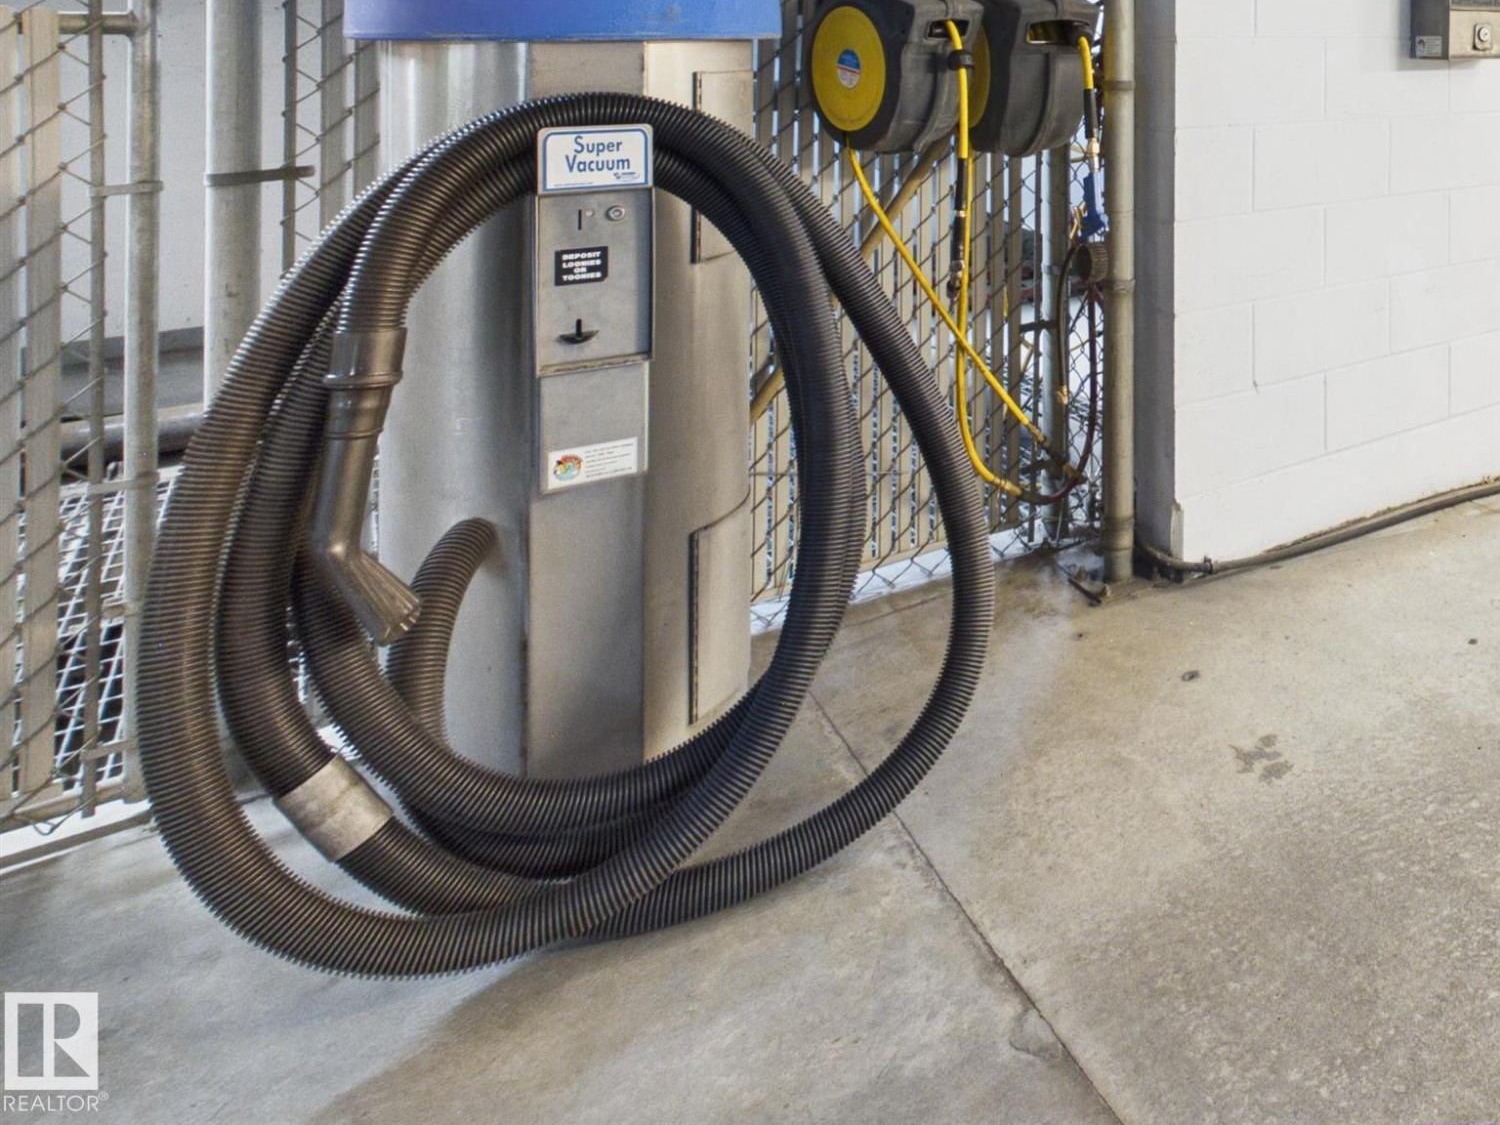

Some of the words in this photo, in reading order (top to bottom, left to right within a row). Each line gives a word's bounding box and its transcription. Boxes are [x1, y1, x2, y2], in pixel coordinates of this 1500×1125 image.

[574, 135, 622, 156] Super
[565, 155, 630, 173] Vacuum
[562, 251, 601, 261] DEPOSIT
[562, 259, 601, 268] LOONIES
[562, 271, 601, 281] TOONIES
